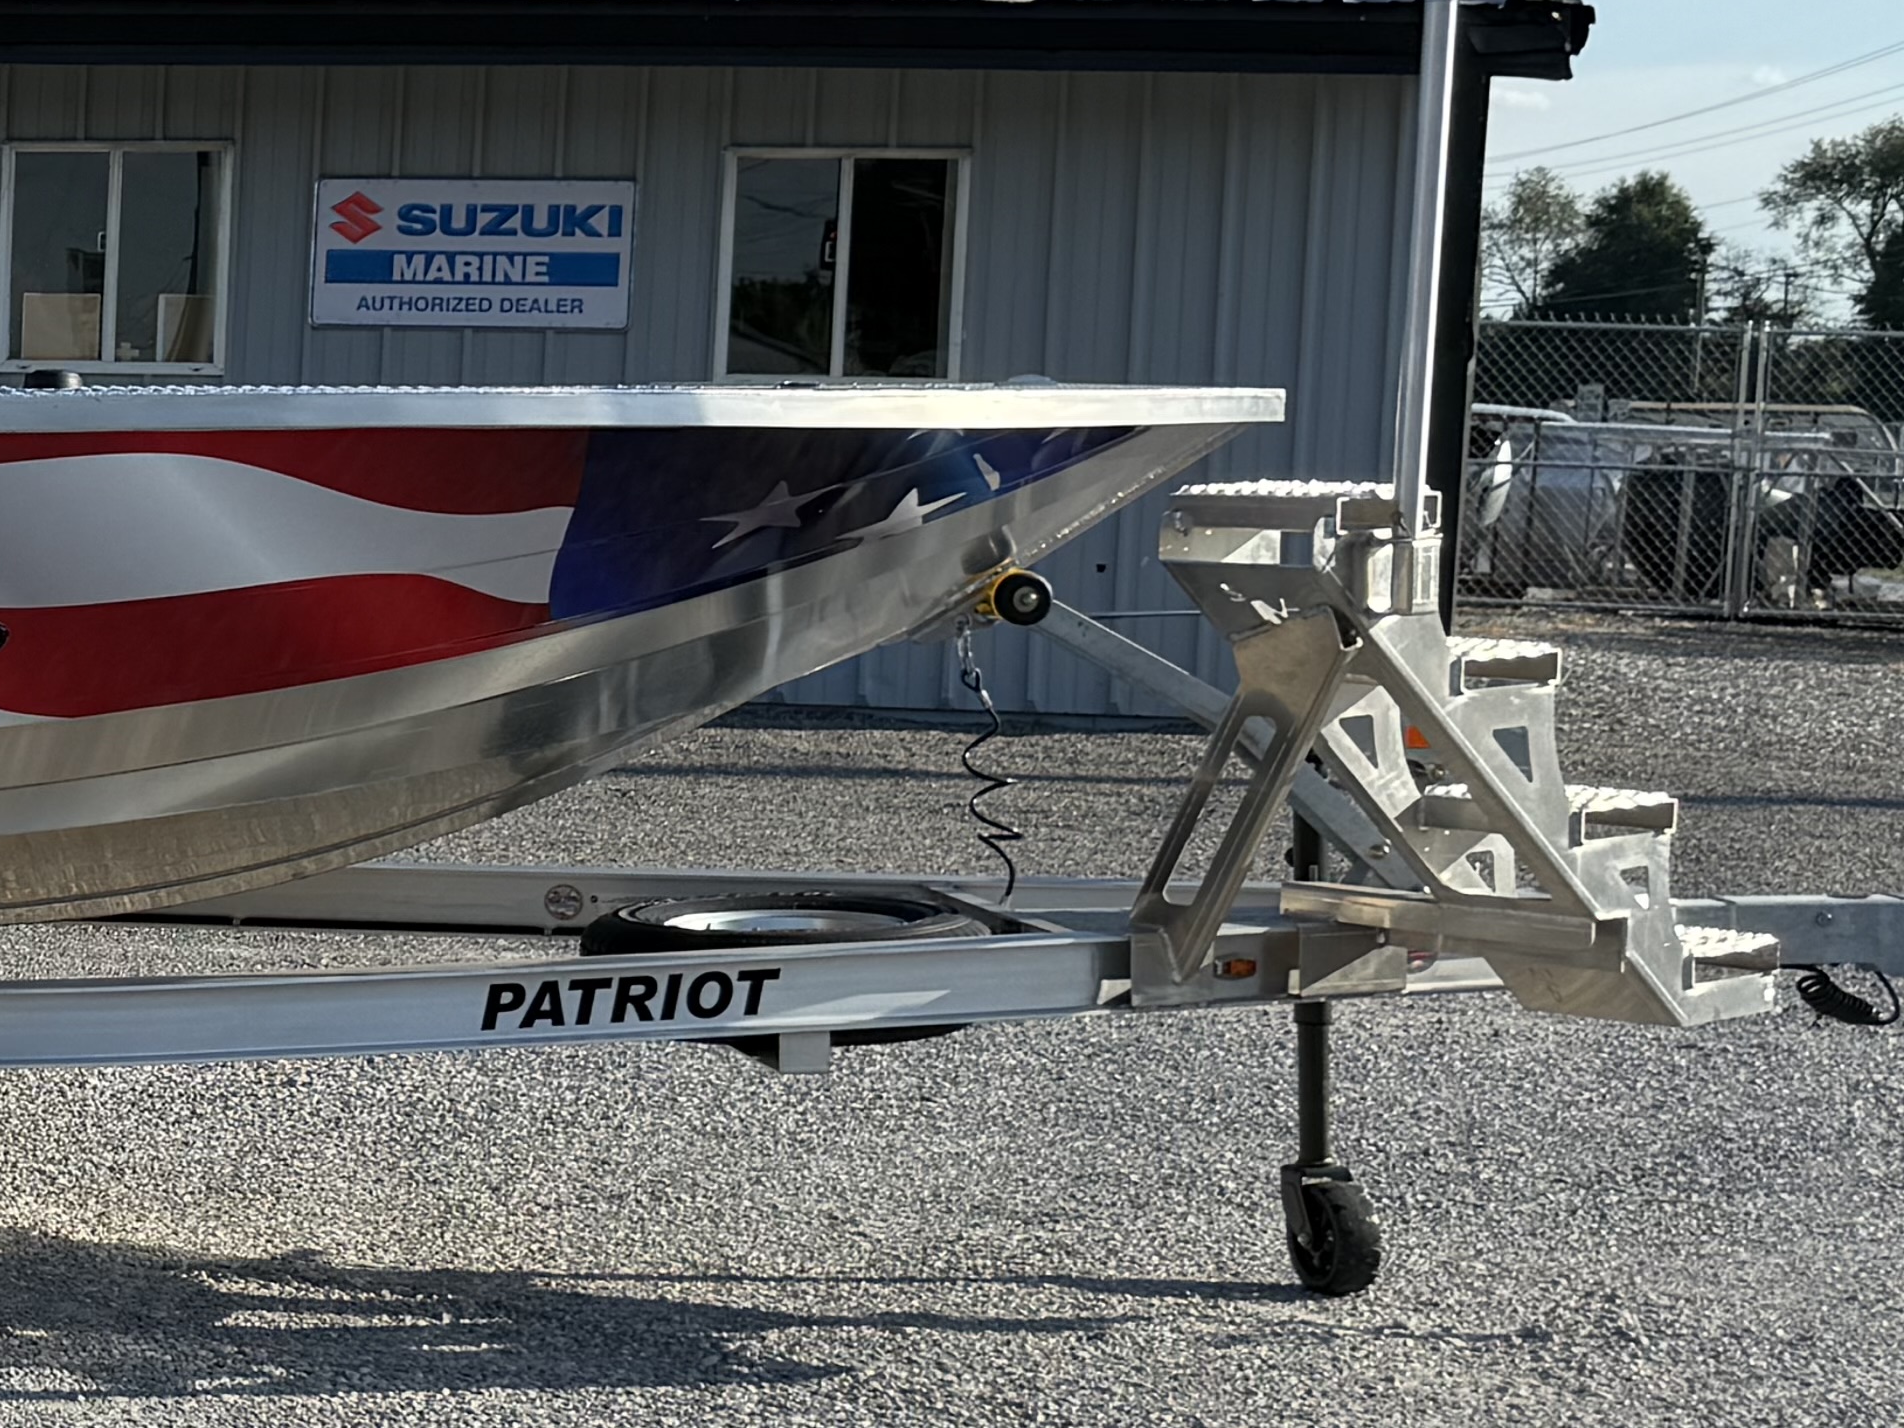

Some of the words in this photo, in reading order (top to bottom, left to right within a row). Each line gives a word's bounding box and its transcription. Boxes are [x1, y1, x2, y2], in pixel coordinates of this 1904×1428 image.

[396, 203, 623, 238] SUZUKI
[392, 254, 550, 283] MARINE
[356, 295, 493, 314] AUTHORIZED
[500, 297, 584, 314] DEALER
[480, 968, 781, 1031] PATRIOT
